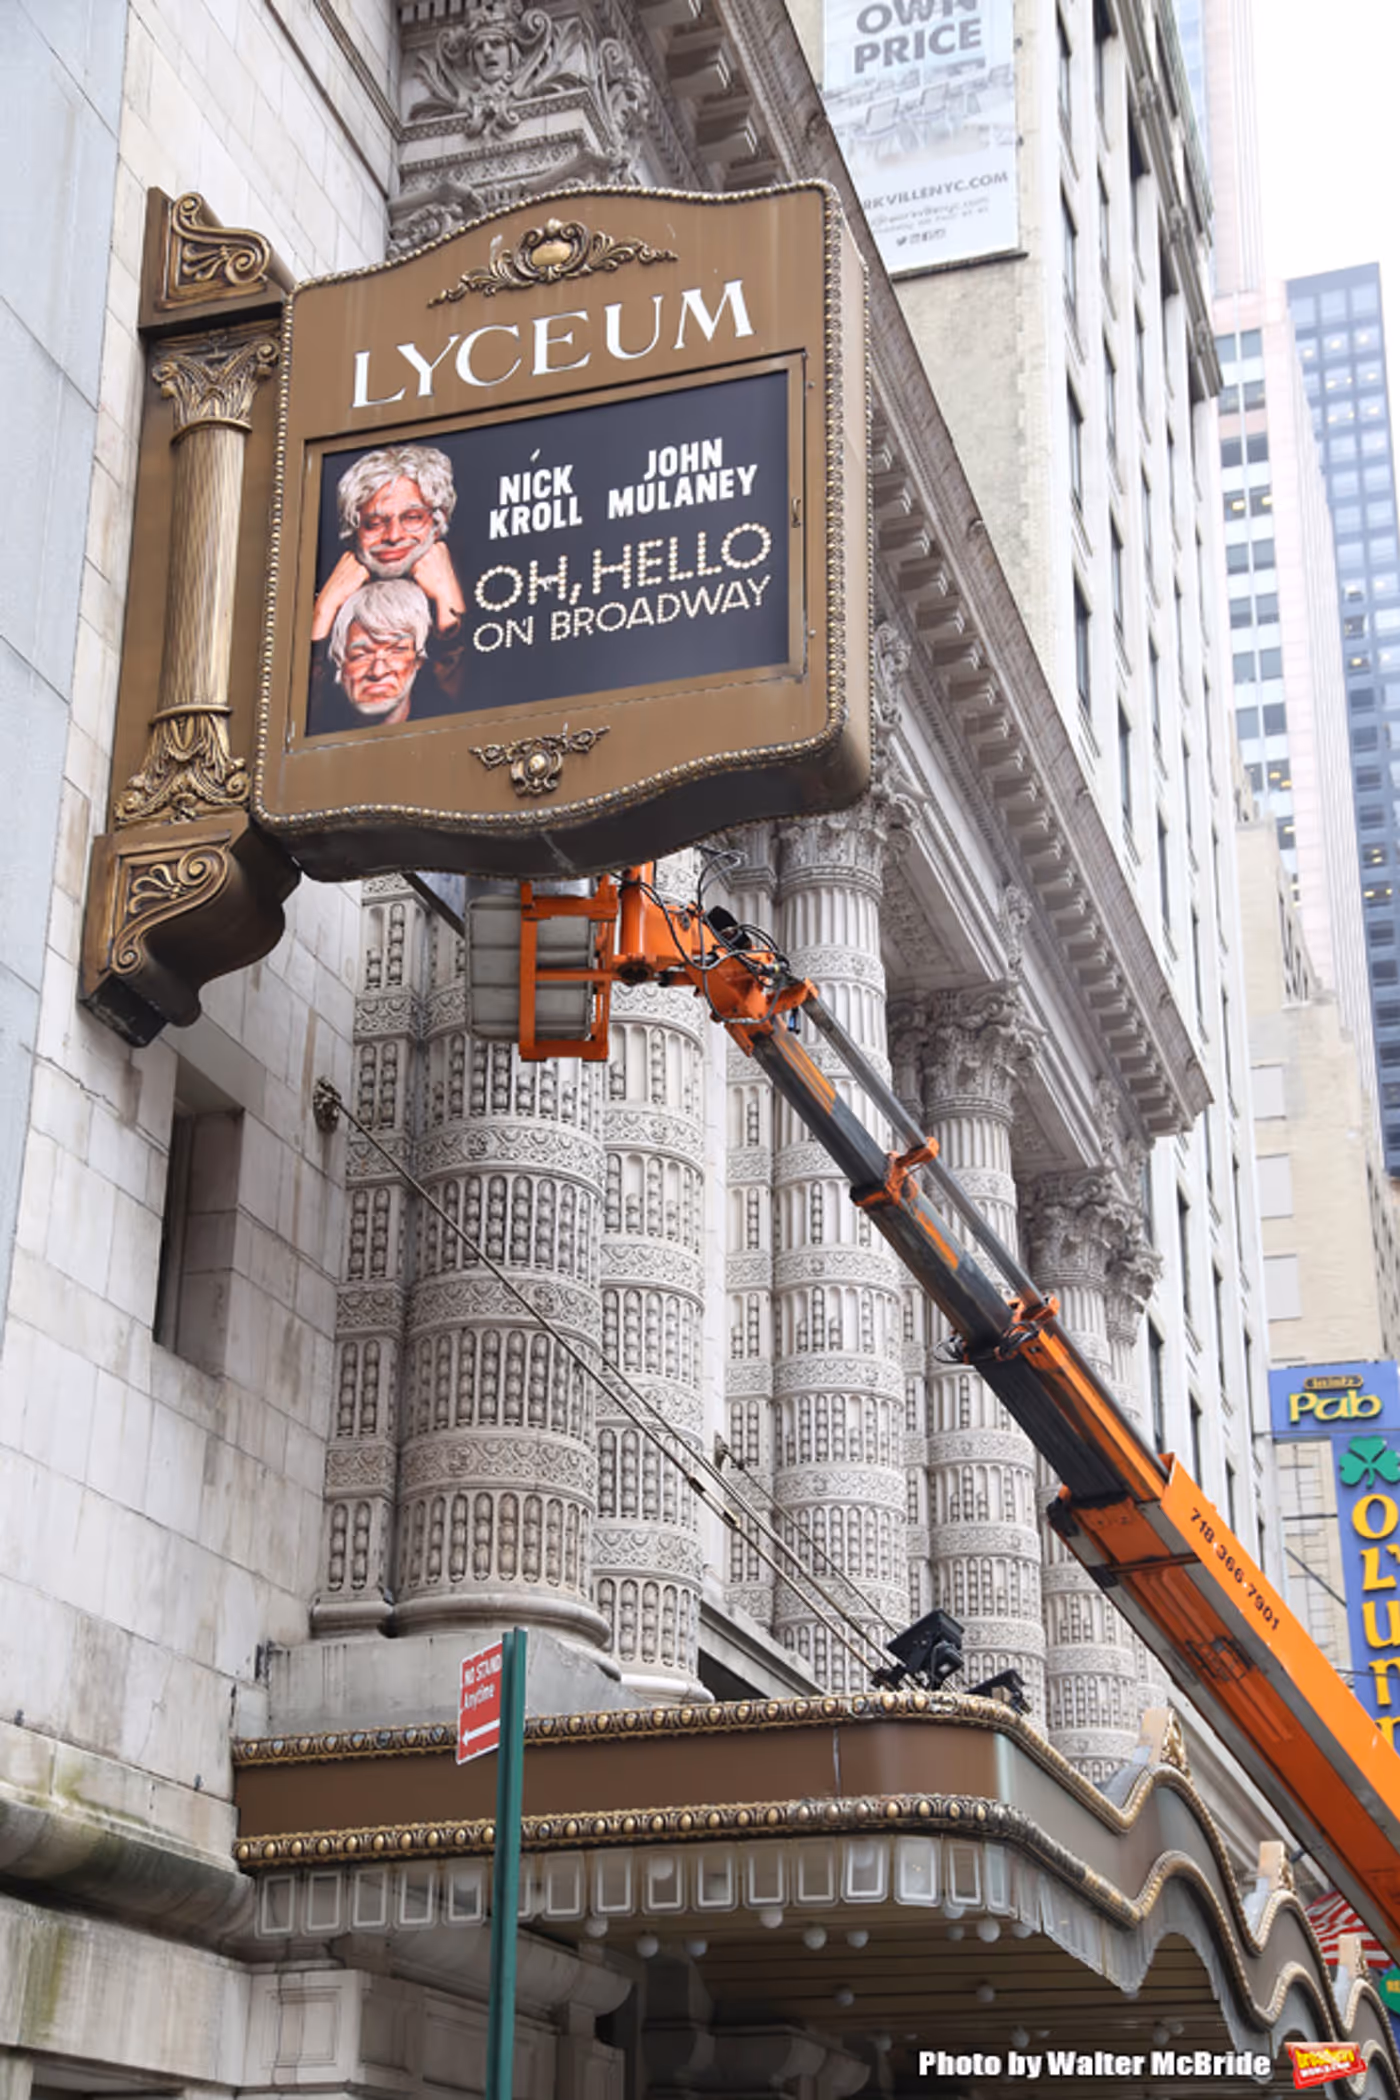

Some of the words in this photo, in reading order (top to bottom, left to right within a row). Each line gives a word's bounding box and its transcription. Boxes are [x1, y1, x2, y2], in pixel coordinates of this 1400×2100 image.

[854, 19, 982, 74] PRICE
[863, 171, 1009, 211] RKVILLENYC.COM
[351, 280, 755, 408] LYCEUM
[499, 465, 574, 505] NICK
[643, 438, 723, 482] JOHN
[488, 497, 583, 540] KROLL
[608, 465, 758, 519] MULANEY
[473, 555, 582, 612] OH,
[593, 522, 772, 595] HELLO
[472, 617, 534, 653] ON
[550, 575, 771, 642] BROADWAY
